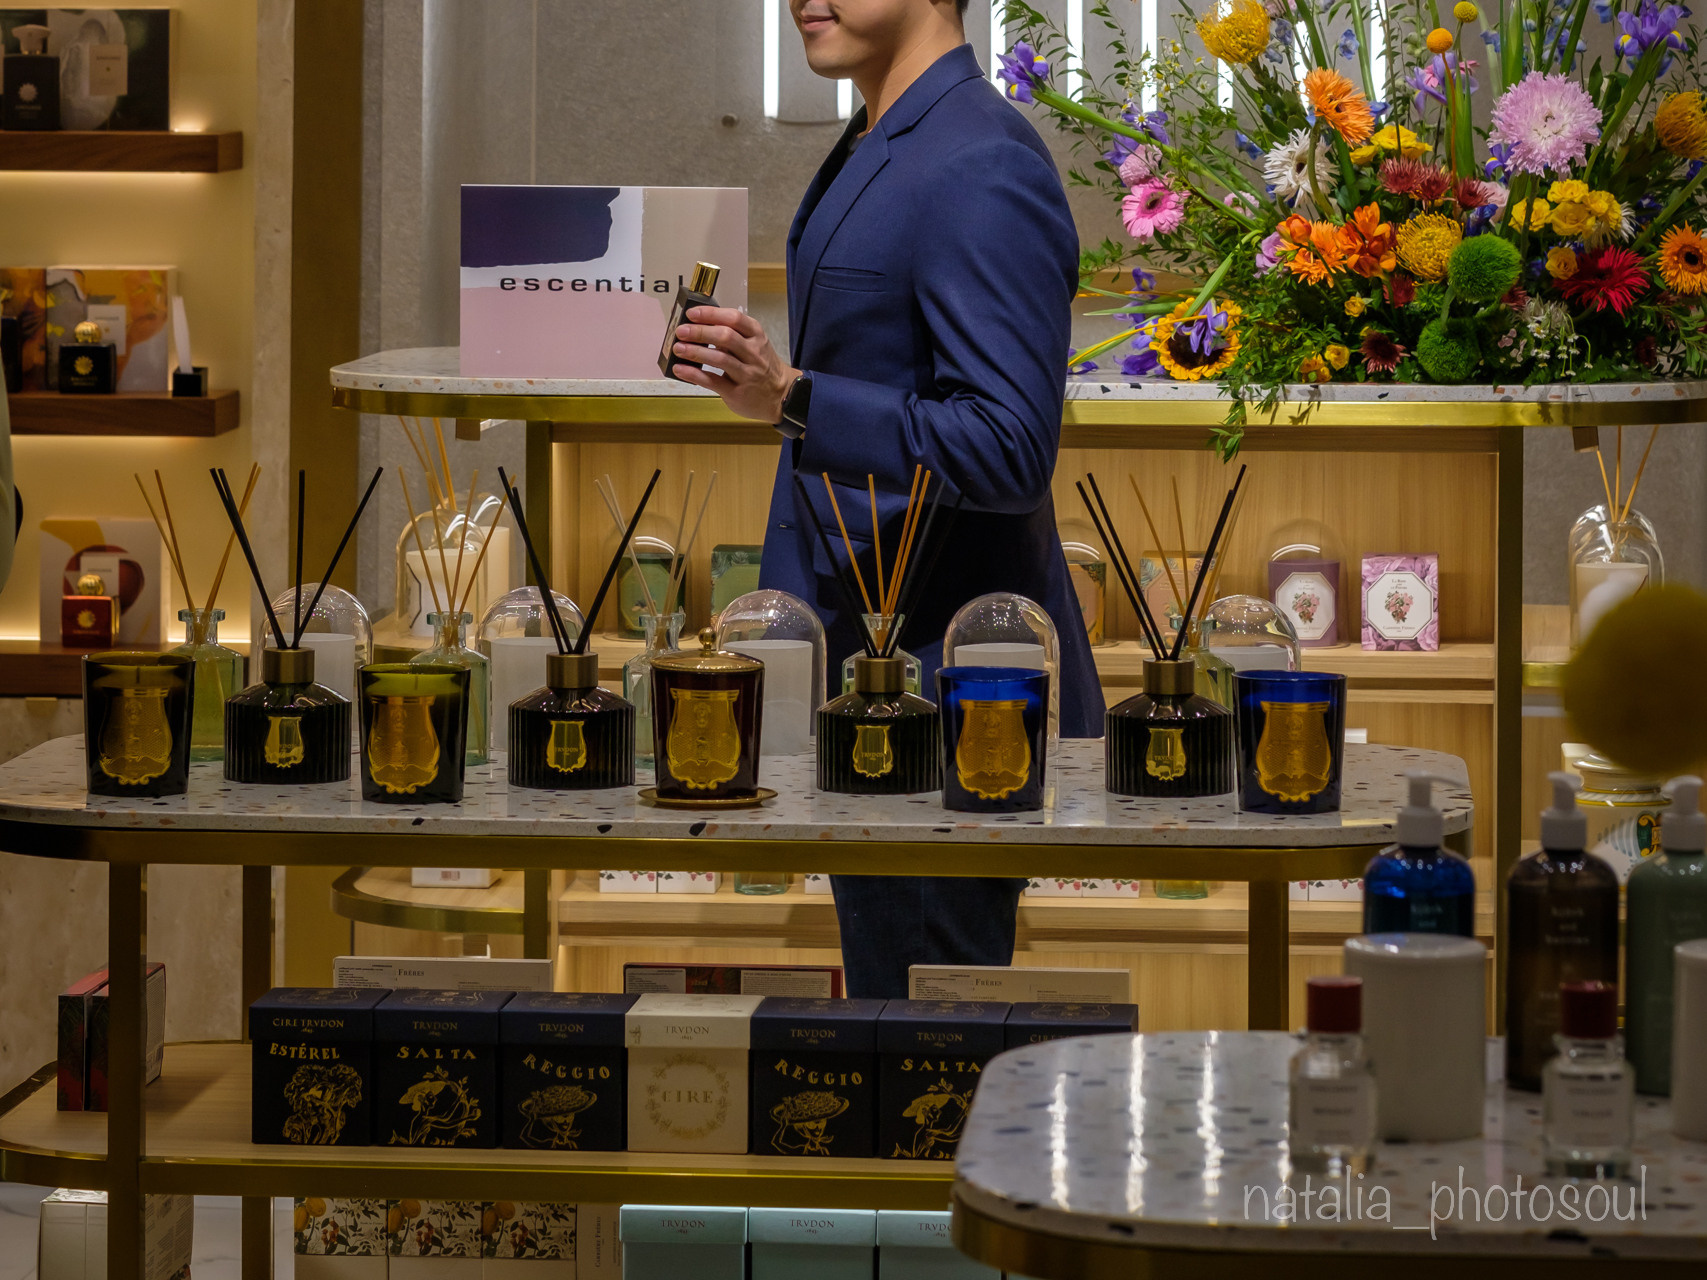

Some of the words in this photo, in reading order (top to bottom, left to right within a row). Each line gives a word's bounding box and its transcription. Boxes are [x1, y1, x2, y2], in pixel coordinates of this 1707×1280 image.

[500, 275, 684, 293] escential
[269, 1042, 340, 1060] ESTÉREL
[396, 1046, 477, 1060] SALTA
[522, 1053, 610, 1080] REGGIO
[774, 1058, 863, 1086] REGGIO
[901, 1058, 981, 1073] SALTA
[662, 1090, 714, 1104] CIRE
[918, 1222, 952, 1231] TRVDO
